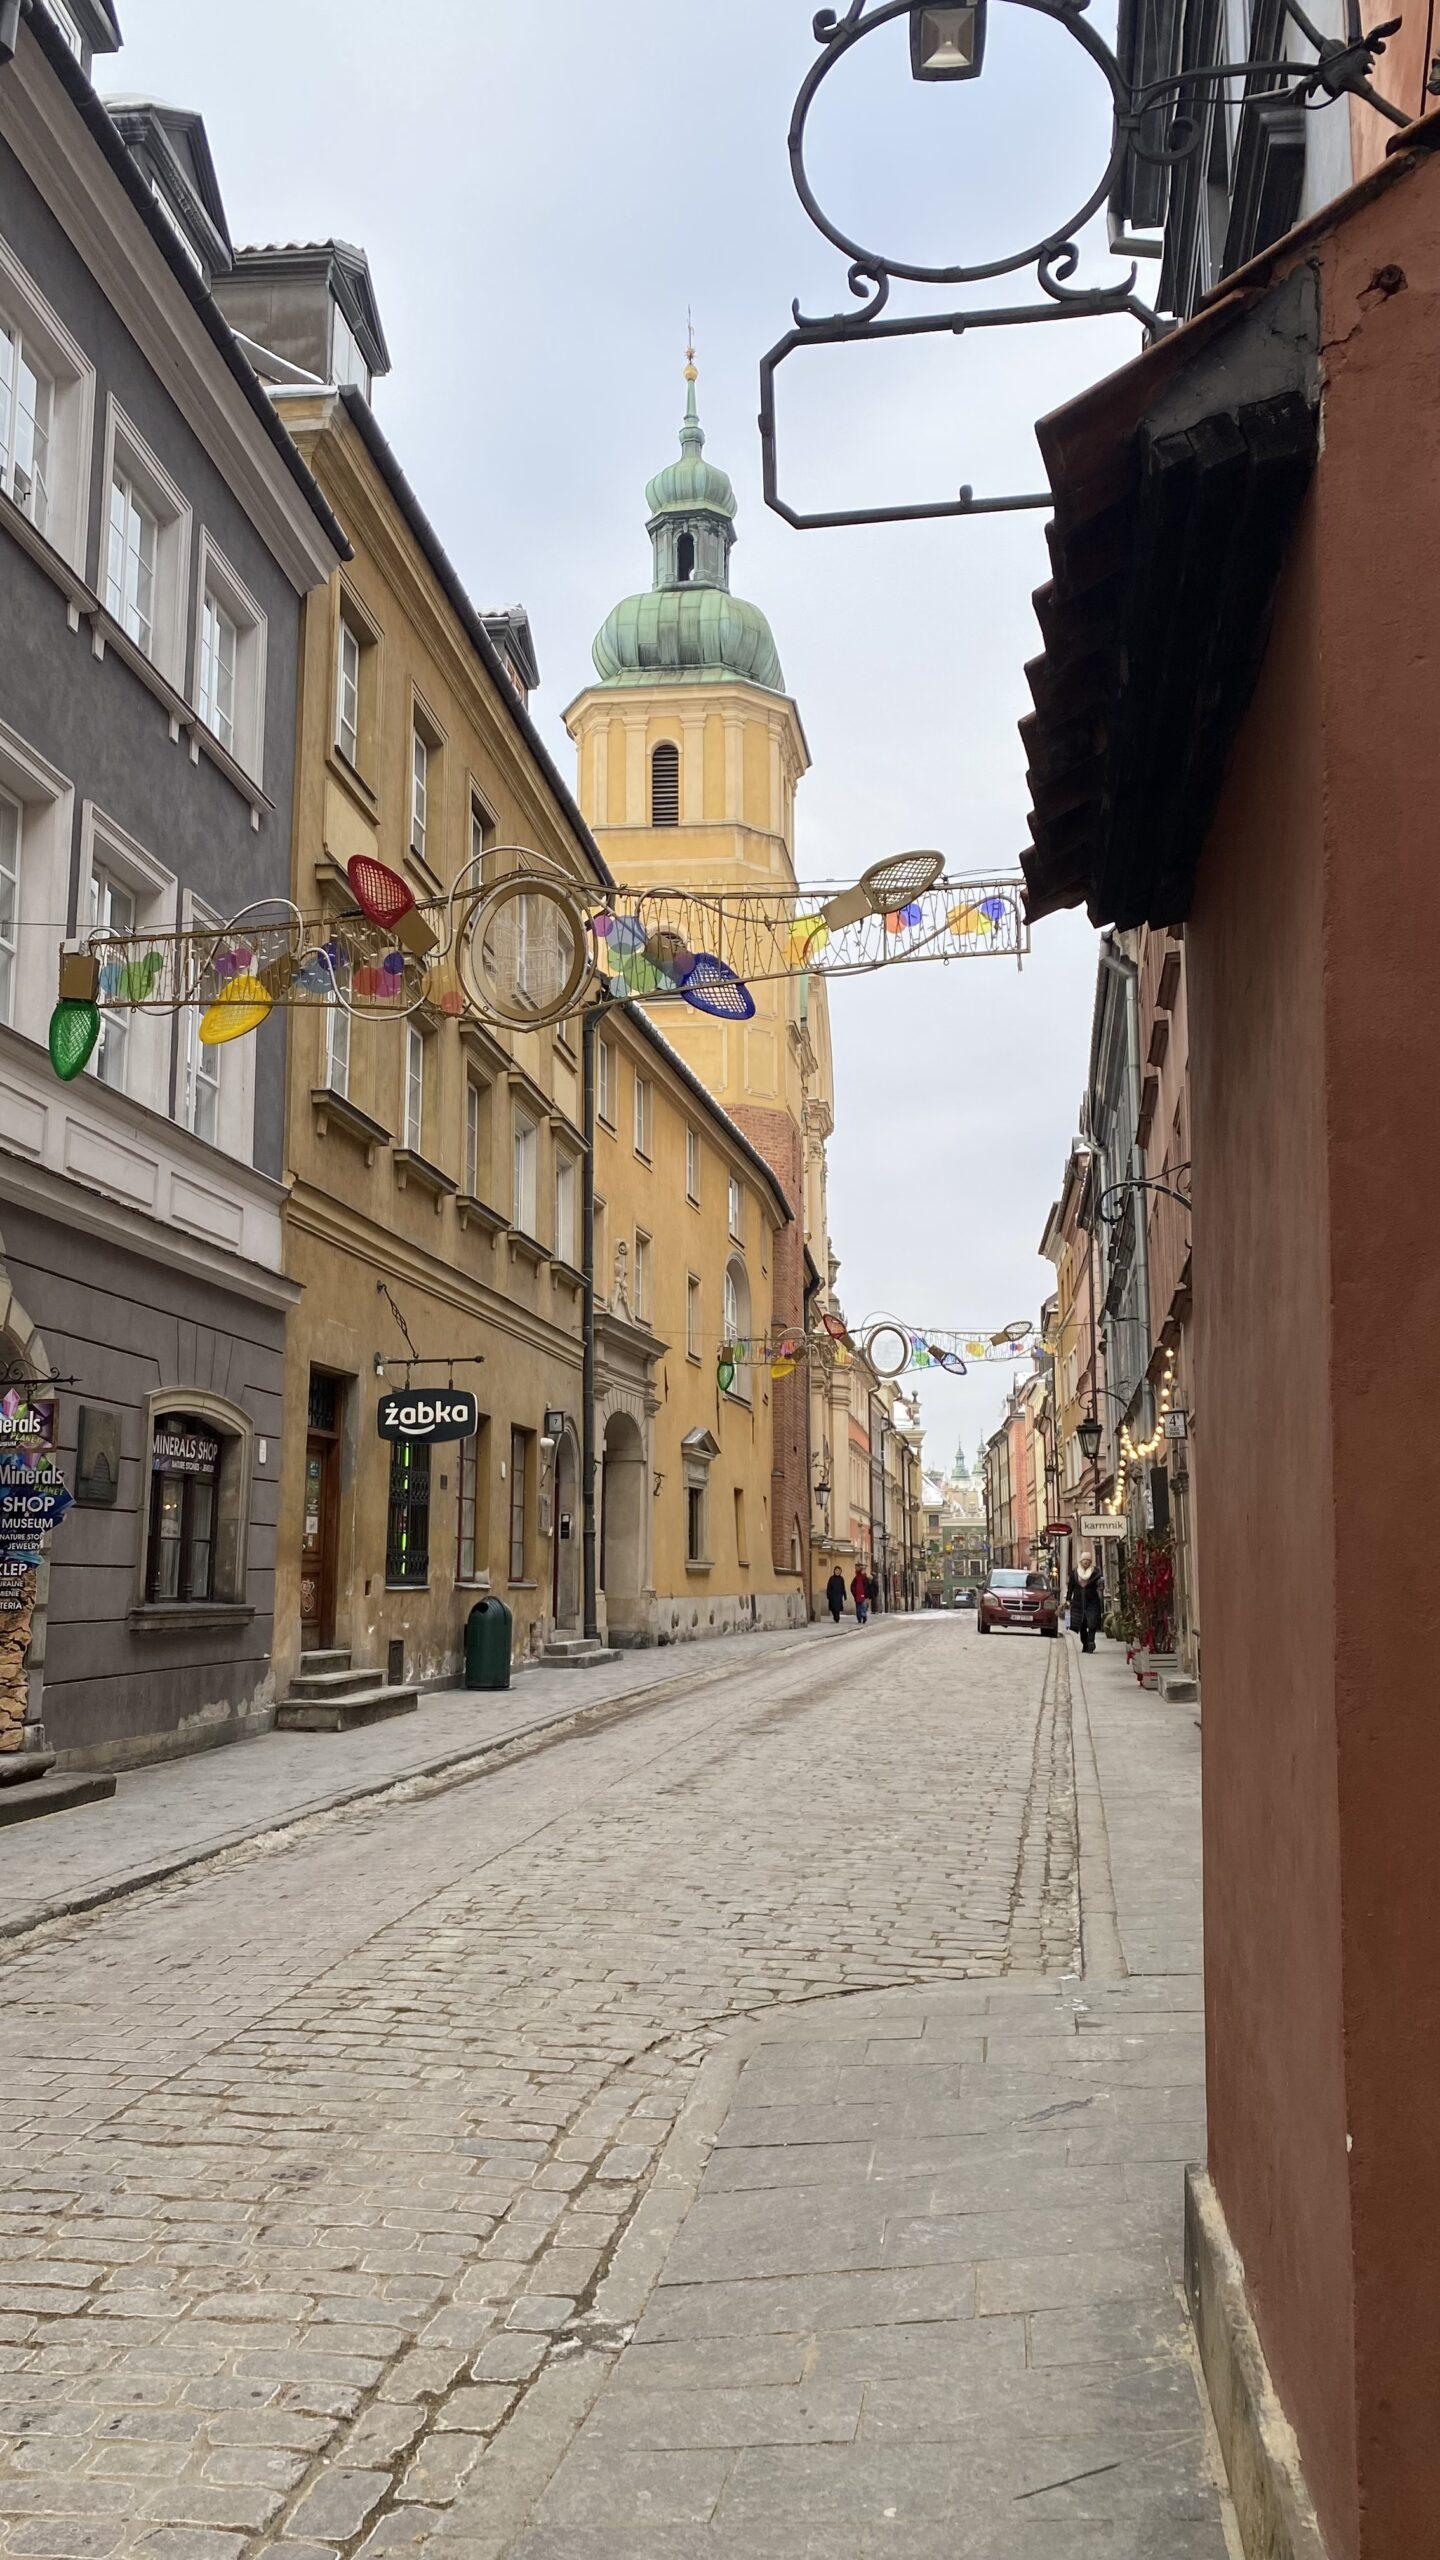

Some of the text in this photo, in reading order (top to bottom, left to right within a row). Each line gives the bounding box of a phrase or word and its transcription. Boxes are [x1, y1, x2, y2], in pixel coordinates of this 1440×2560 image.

[385, 1401, 468, 1425] żabka
[198, 1441, 218, 1461] SHOP
[3, 1496, 55, 1512] SHOP
[2, 1518, 53, 1528] MUSEUM
[1084, 1521, 1124, 1530] karmnik
[7, 1542, 40, 1550] JEWELRY
